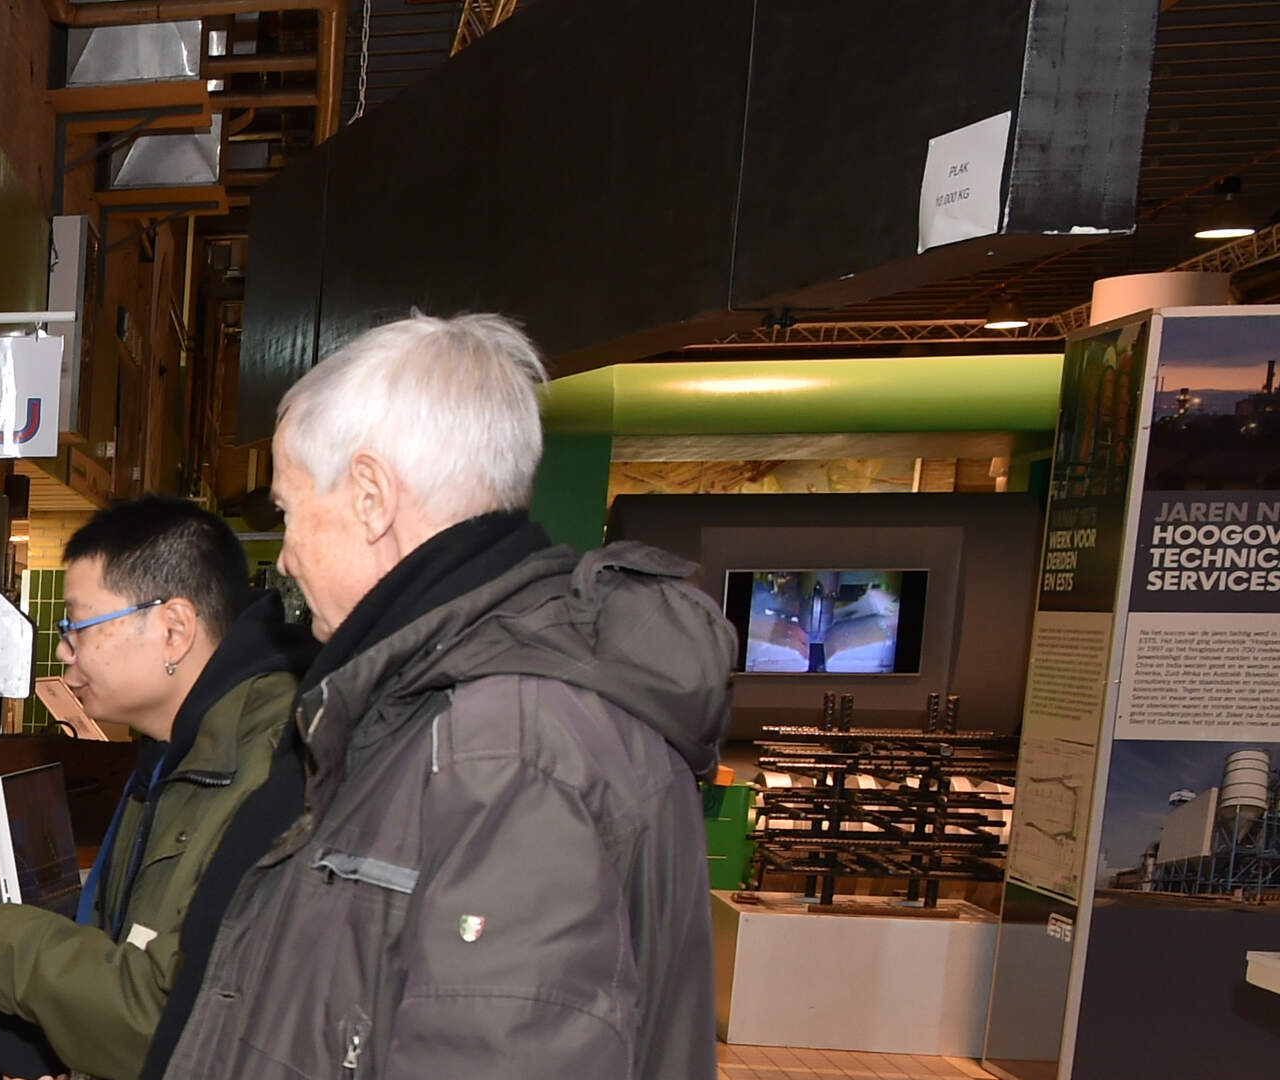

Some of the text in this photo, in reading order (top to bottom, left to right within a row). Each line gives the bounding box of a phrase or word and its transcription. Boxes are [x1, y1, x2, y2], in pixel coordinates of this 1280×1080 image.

[947, 162, 970, 177] PLAK
[958, 187, 970, 200] KG
[1154, 502, 1249, 521] JAREN
[1049, 528, 1097, 549] WERK VOOR
[1046, 551, 1078, 570] DERDEN
[1150, 547, 1280, 569] TECHNIC
[1043, 572, 1074, 591] EN ESTS
[1146, 570, 1280, 592] SERVICES
